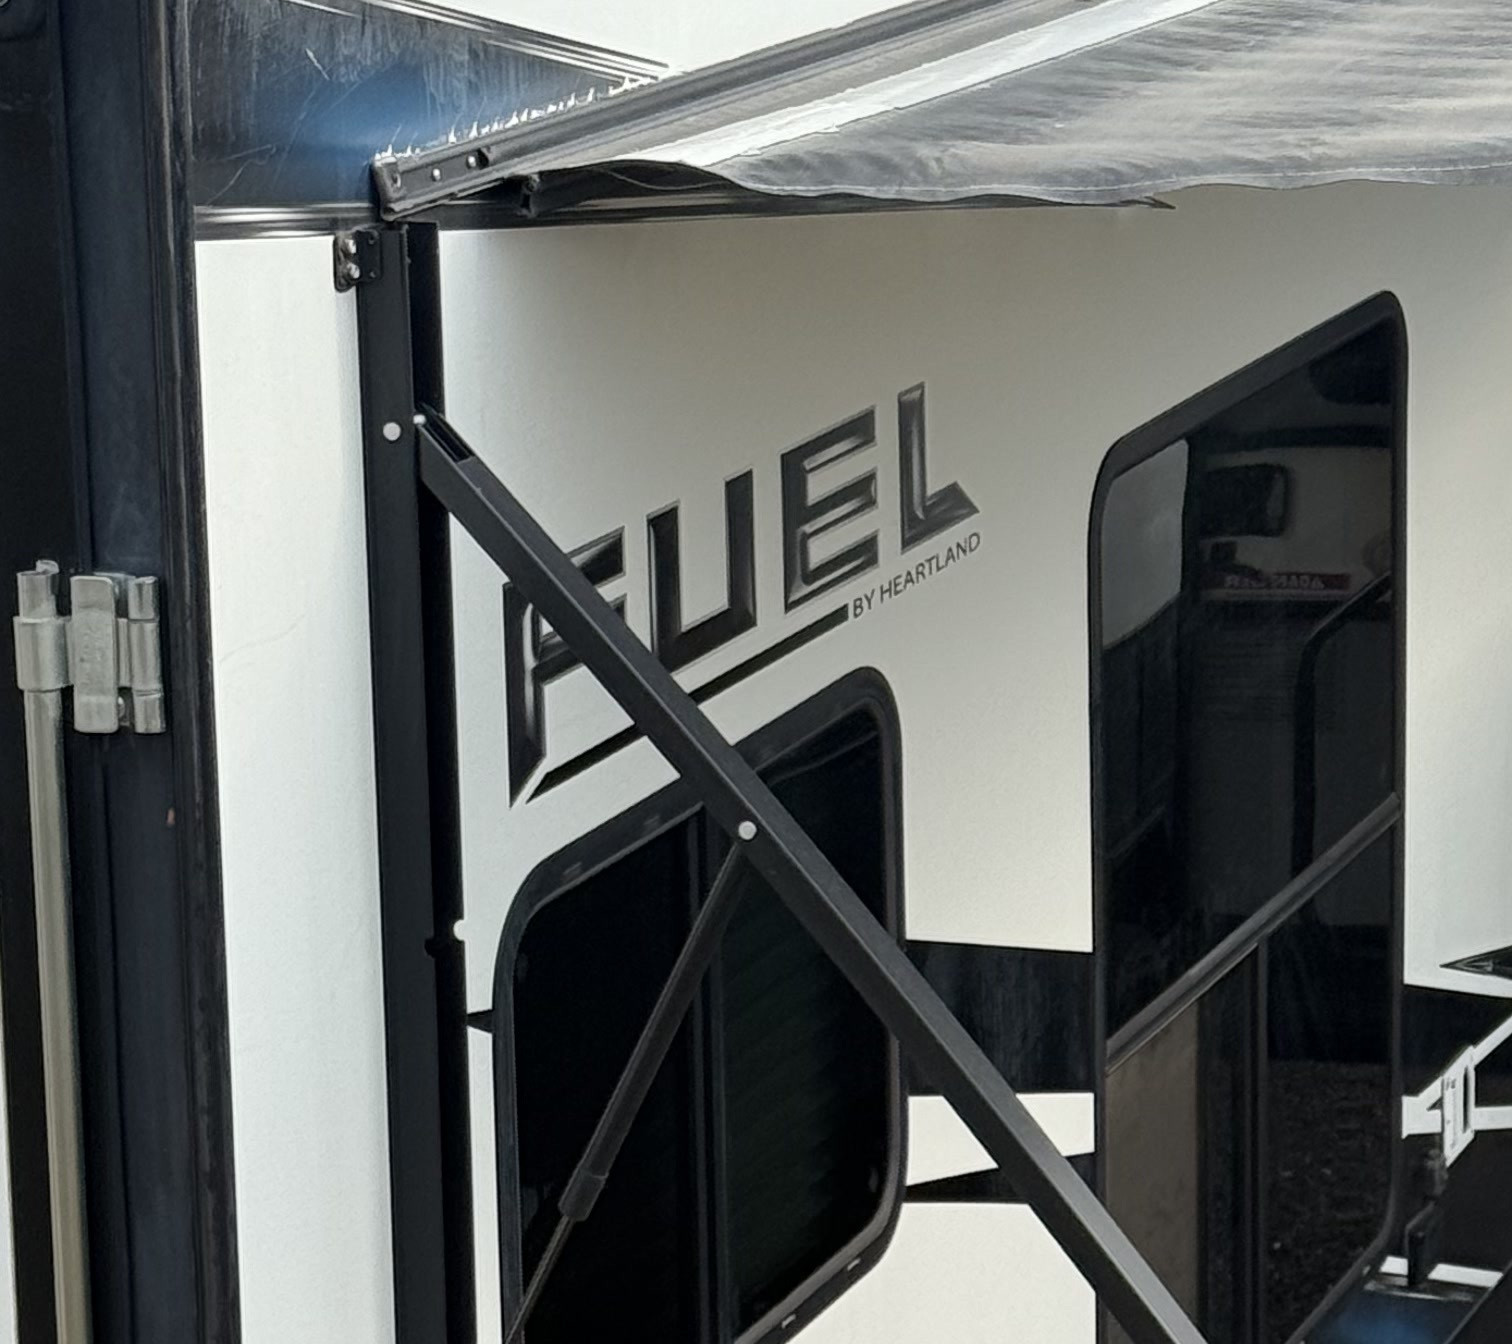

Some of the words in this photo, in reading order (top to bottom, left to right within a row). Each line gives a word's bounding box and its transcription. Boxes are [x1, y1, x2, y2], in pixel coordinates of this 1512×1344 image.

[503, 381, 981, 809] FUEL
[853, 588, 876, 619] BY
[879, 532, 981, 605] HEARTLAND
